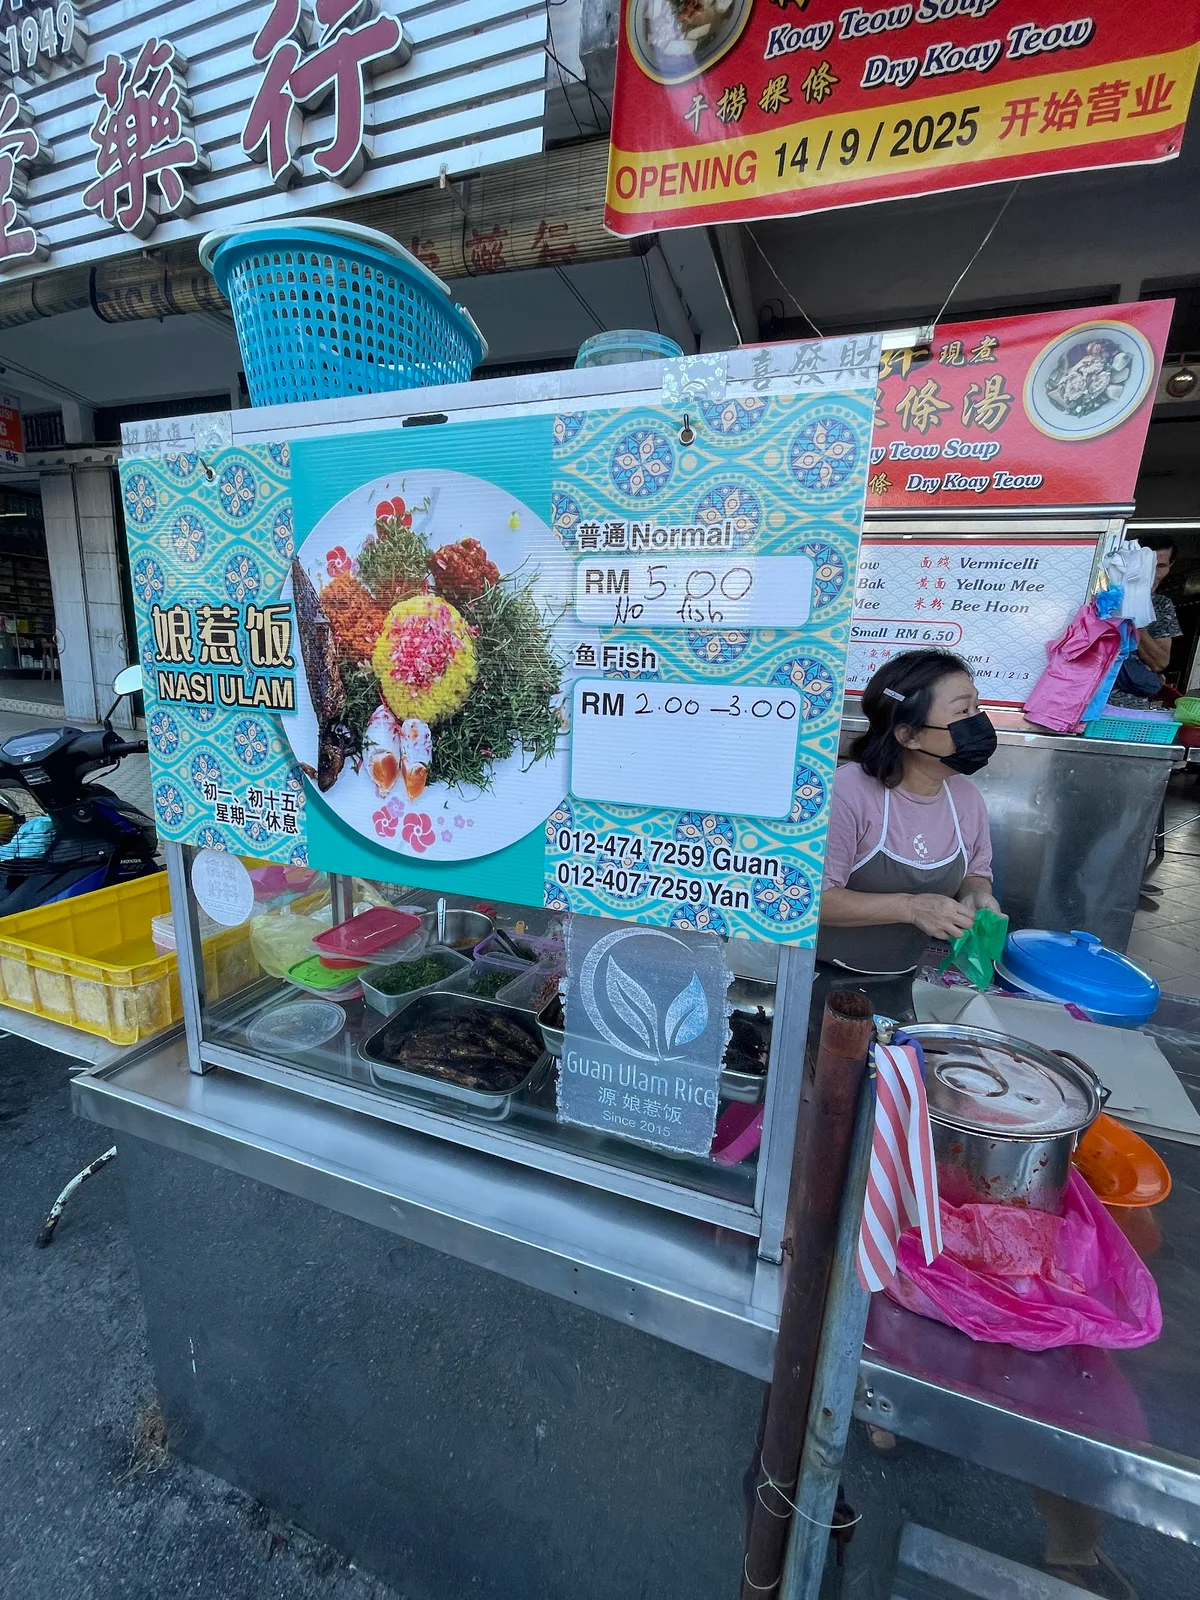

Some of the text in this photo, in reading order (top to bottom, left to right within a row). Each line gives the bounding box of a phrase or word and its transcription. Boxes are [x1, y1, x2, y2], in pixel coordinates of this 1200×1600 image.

[5, 1, 76, 74] 1949
[765, 0, 998, 60] Koay Teow Soup
[860, 18, 1095, 89] Dry Koay Teow
[614, 149, 759, 200] OPENING
[774, 142, 808, 177] 14
[889, 106, 980, 157] 2025
[999, 72, 1177, 142] 开始营业
[728, 334, 879, 392] 喜發財
[888, 440, 942, 461] Teow
[943, 437, 1001, 461] Soup
[905, 472, 1044, 493] Dry Koay Teow
[579, 523, 626, 550] 普通
[631, 521, 732, 549] Normal
[959, 556, 1040, 571] Vermicelli
[584, 564, 753, 601] RM 5.00
[857, 576, 886, 590] Bak
[955, 578, 1045, 593] Yellow Mee
[613, 594, 724, 627] No fish
[913, 597, 945, 611] 米粉
[950, 599, 1030, 614] Bee Hoon
[151, 602, 295, 668] 娘惹饭
[850, 626, 955, 642] Small RM 6.50
[575, 643, 597, 667] 鱼
[602, 646, 656, 670] Fish
[976, 669, 992, 678] RM
[157, 670, 295, 711] NASI ULAM
[581, 691, 625, 717] RM
[634, 692, 700, 716] 2.00
[203, 780, 297, 813] 初一、初十五
[216, 803, 299, 834] 星期一休息
[558, 830, 779, 877] 012-474 7259 Guan
[557, 863, 750, 909] 012-407 7259 Yan
[566, 1051, 718, 1109] Guan Ulam Rice
[597, 1085, 683, 1125] 源 娘惹饭
[602, 1110, 671, 1138] Since 2015
